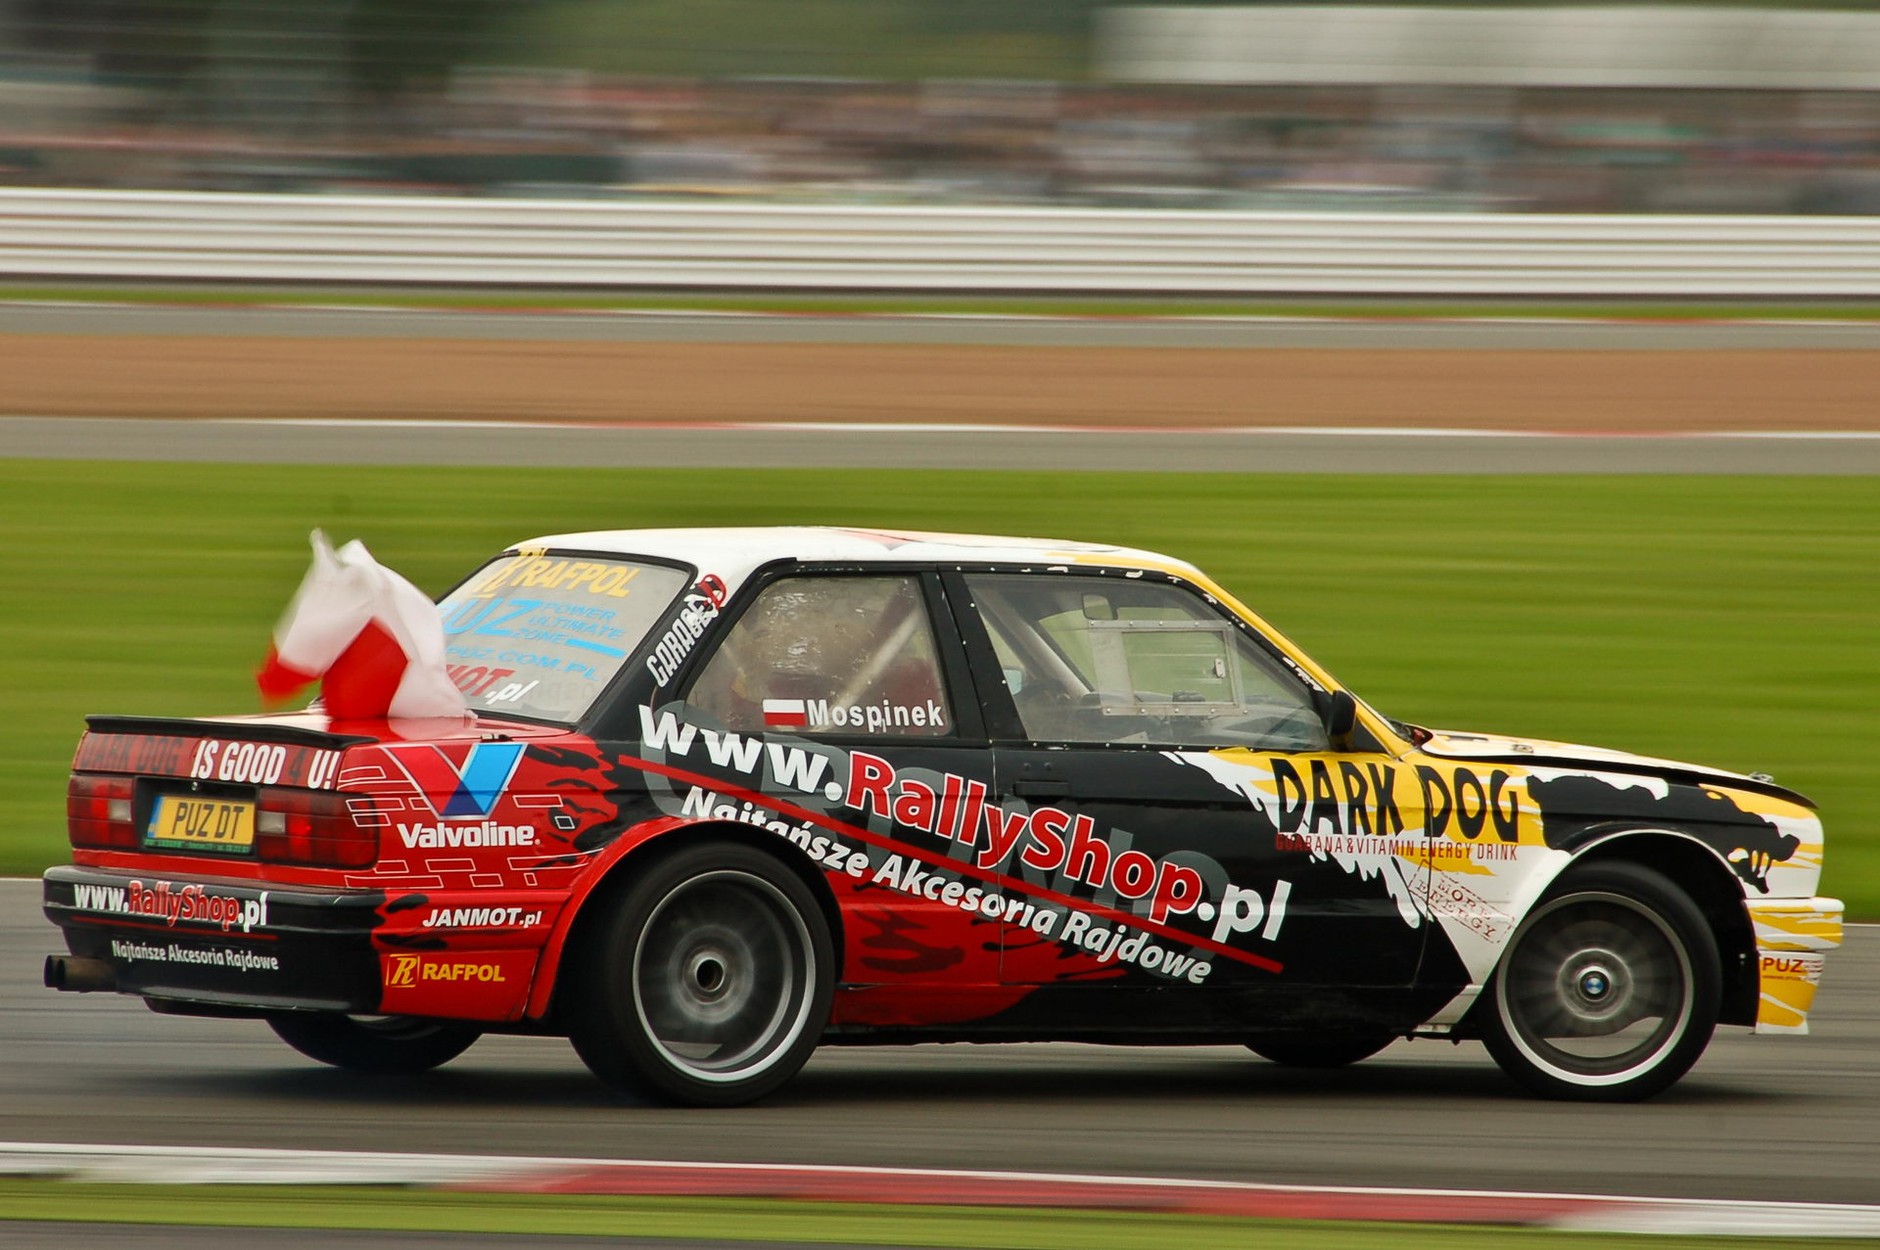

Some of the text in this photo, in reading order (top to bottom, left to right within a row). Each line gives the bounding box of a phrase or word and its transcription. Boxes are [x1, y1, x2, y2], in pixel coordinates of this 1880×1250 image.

[510, 560, 641, 597] RAFPOL
[528, 616, 625, 639] ULTIMATE
[545, 602, 618, 621] POWER
[511, 627, 567, 644] ZONE
[807, 699, 944, 732] Mospinek
[136, 736, 183, 774] DOG
[190, 740, 219, 779] IS
[218, 742, 286, 785] GOOD
[288, 749, 307, 782] 4
[306, 750, 340, 789] U!
[1270, 758, 1519, 843] DARK DOG
[172, 802, 244, 839] PUZ DT
[638, 704, 1292, 944] www.RallyShop.pl
[1420, 841, 1472, 859] ENERGY
[1477, 843, 1518, 860] DRINK
[73, 880, 269, 932] www.RallyShop.pl
[422, 907, 542, 928] JANMOT.pl
[872, 854, 1058, 935] Akcesoria
[1061, 910, 1212, 985] Rajdowe
[112, 940, 279, 972] Najtańsze Akcesoria Rajdowe
[422, 963, 506, 981] RAFPOL
[1762, 957, 1806, 973] PUZ
